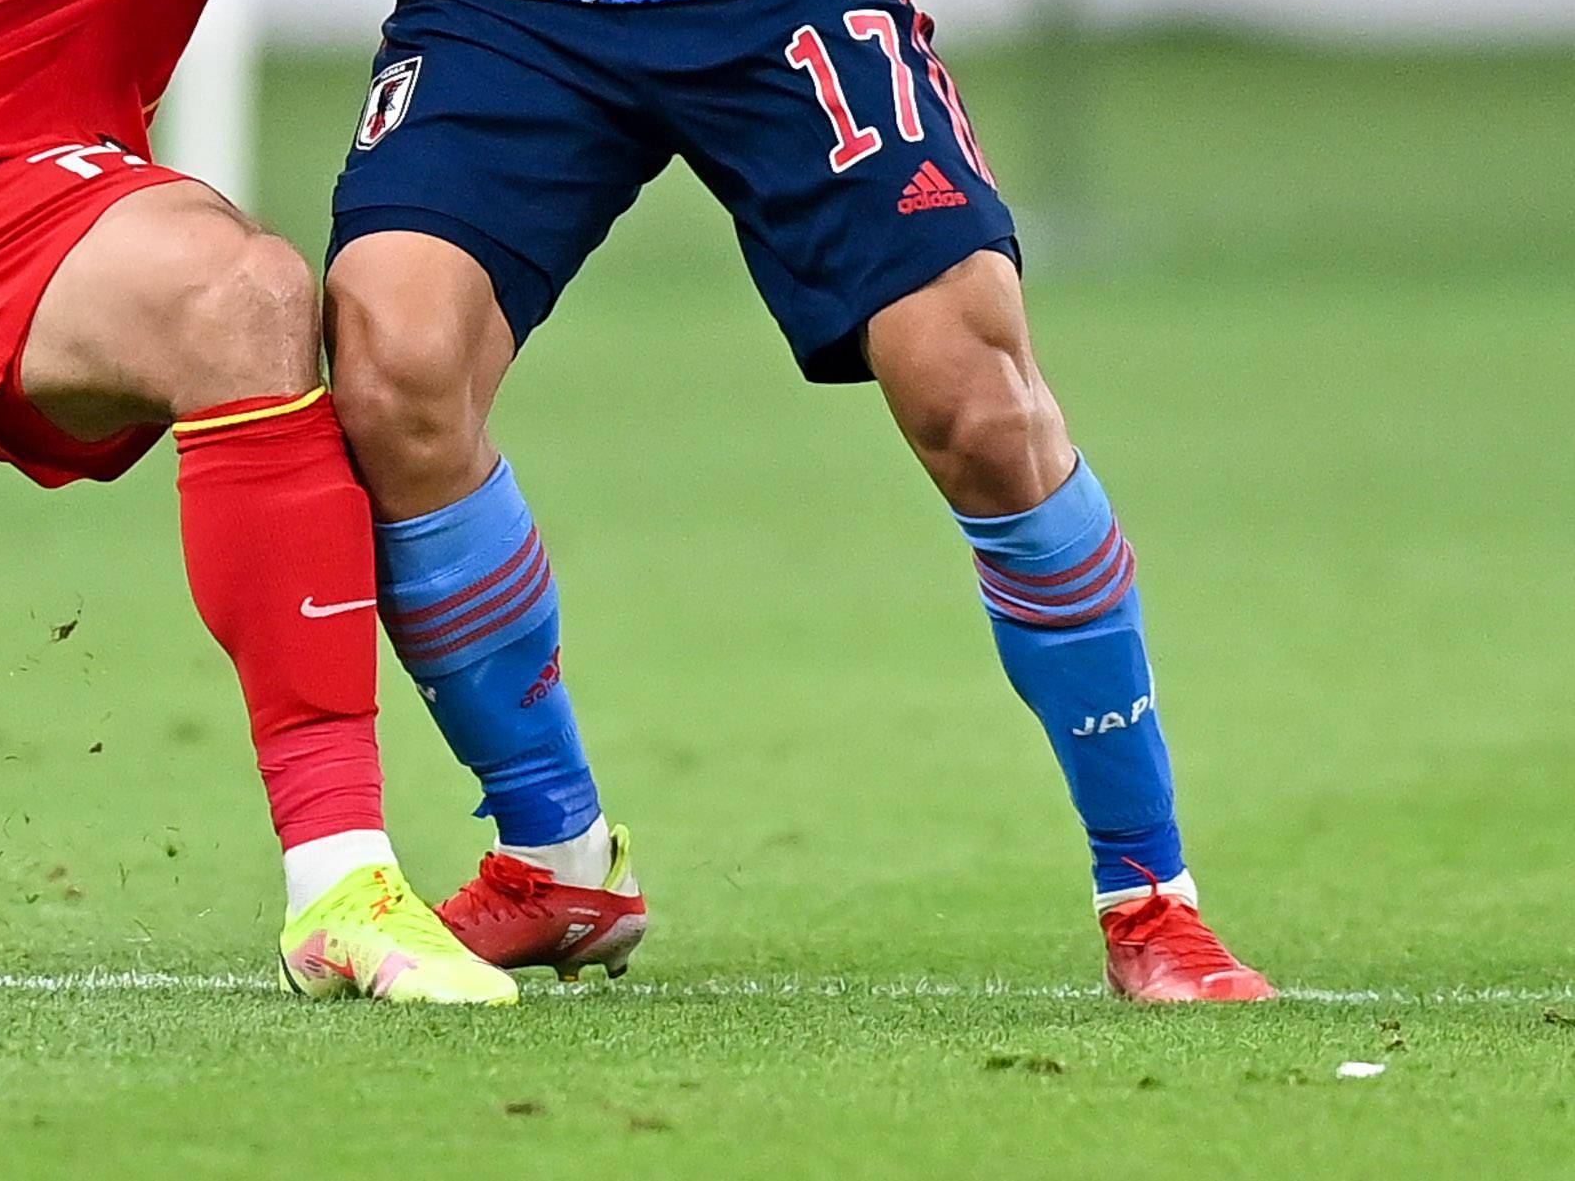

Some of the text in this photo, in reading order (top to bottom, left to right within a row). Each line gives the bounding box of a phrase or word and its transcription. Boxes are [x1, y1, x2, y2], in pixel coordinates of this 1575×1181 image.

[784, 9, 925, 174] 17
[897, 192, 968, 215] adidas
[1072, 695, 1155, 736] JAP
